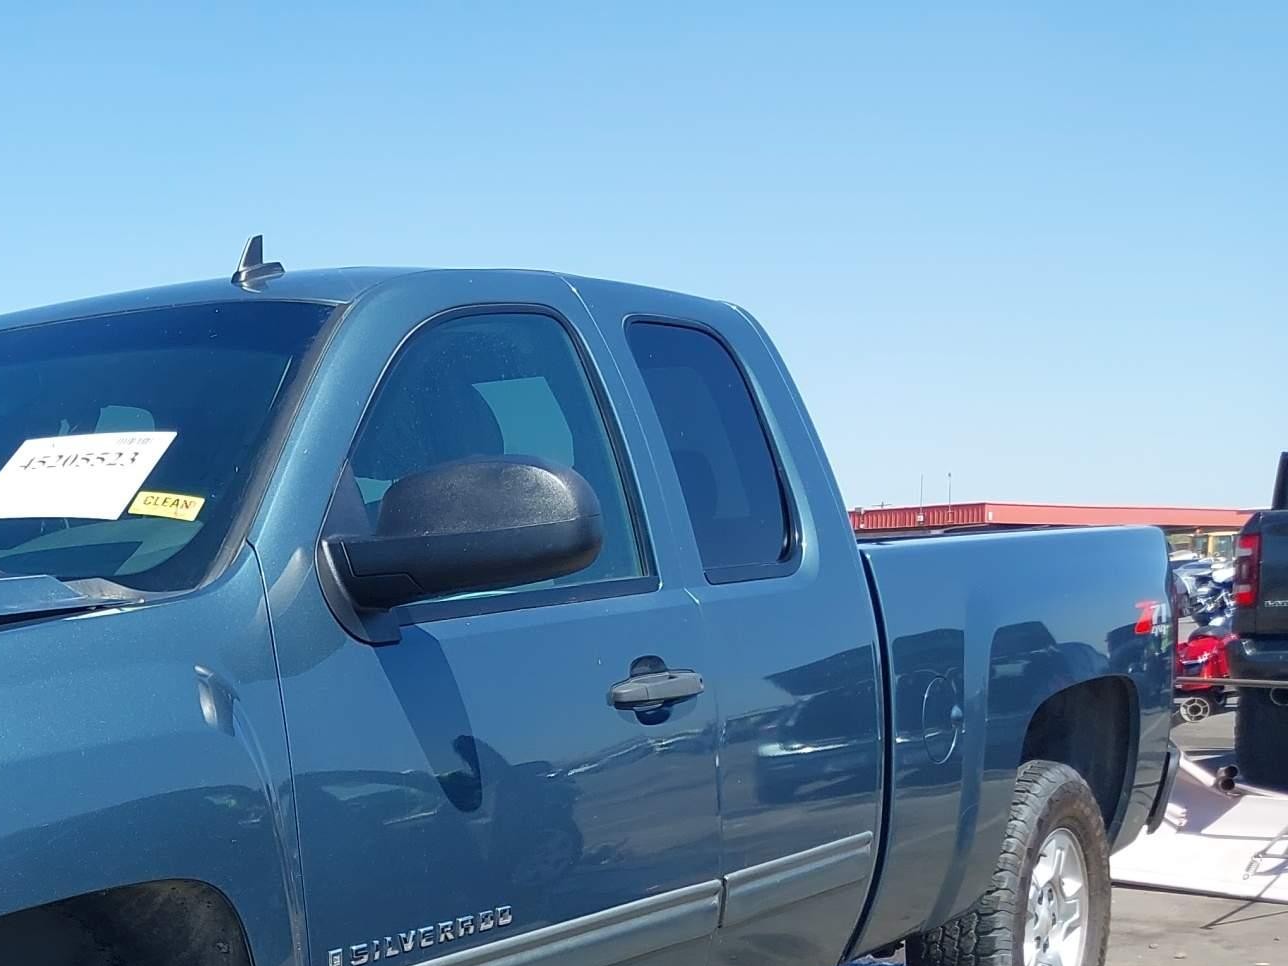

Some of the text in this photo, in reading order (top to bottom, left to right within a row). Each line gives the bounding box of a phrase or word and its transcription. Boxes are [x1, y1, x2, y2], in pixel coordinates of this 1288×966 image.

[19, 450, 140, 471] 45205523
[142, 495, 194, 510] CLEAN
[350, 905, 513, 966] SILVERADO
